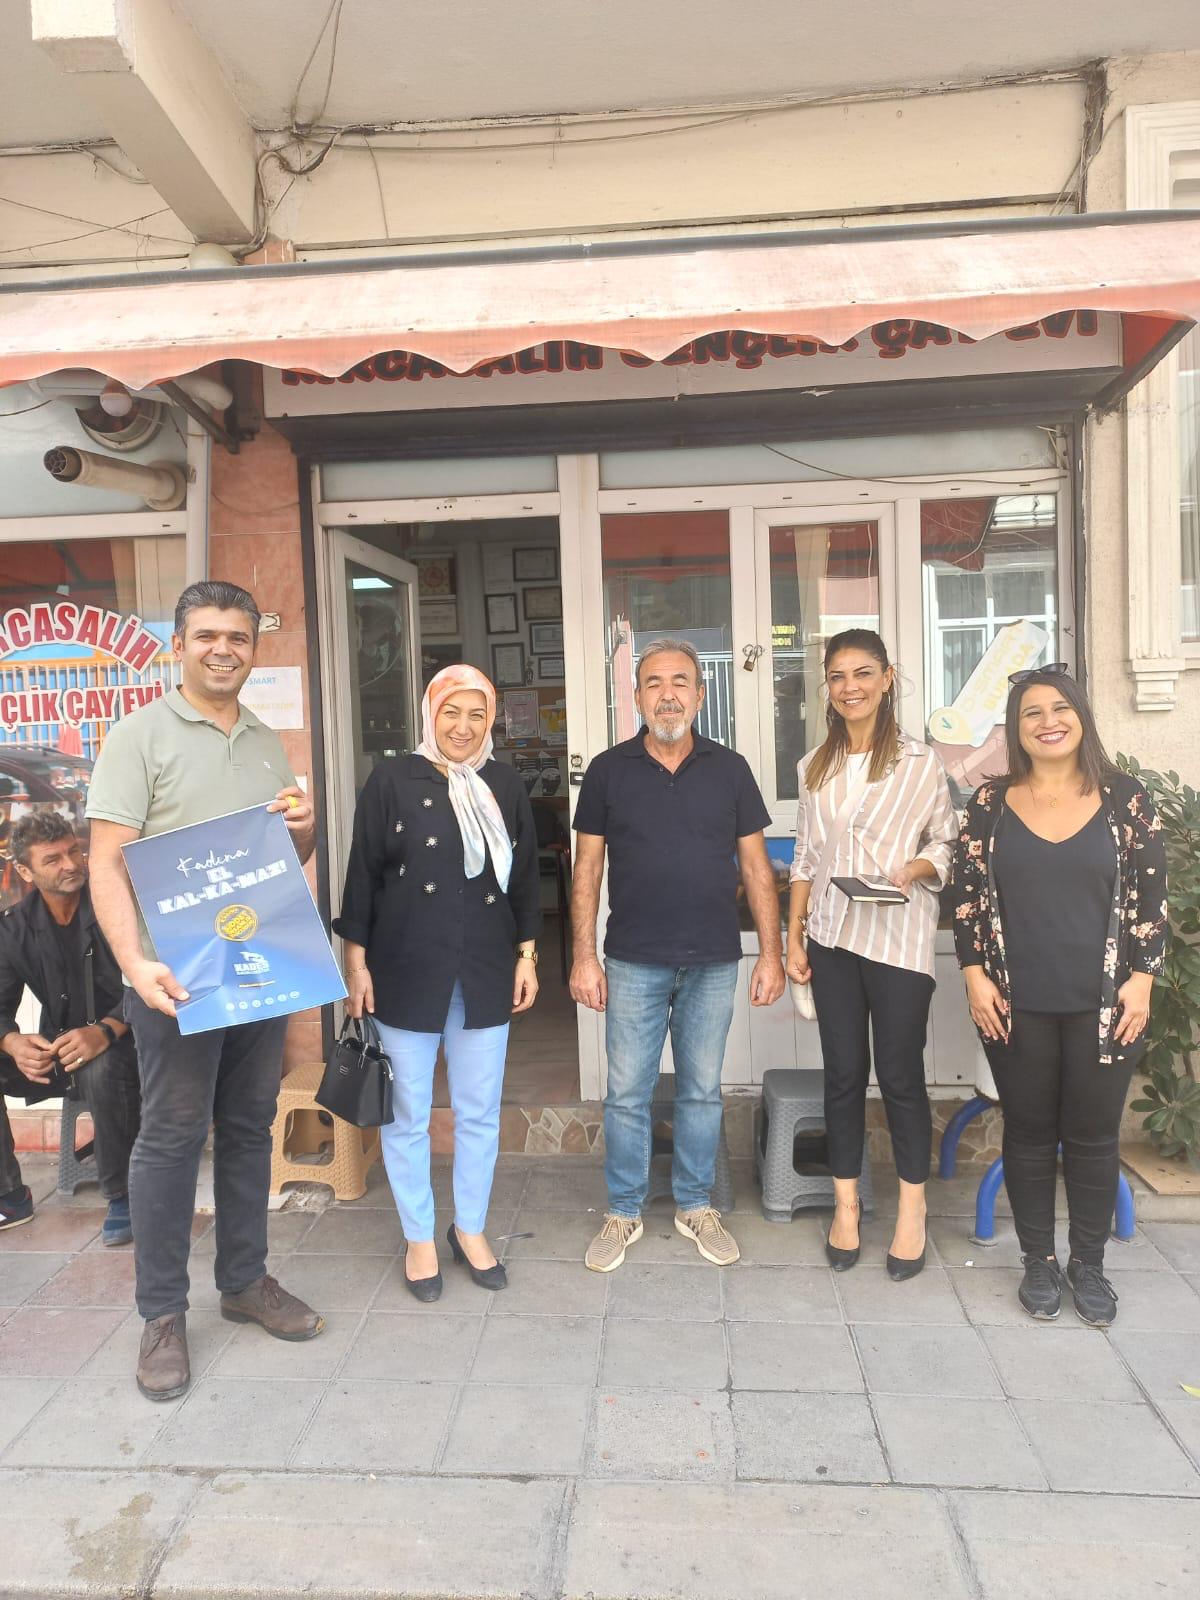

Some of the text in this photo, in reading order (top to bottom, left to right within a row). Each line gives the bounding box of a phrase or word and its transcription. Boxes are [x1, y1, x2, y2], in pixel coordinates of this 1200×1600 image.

[871, 318, 978, 359] ÇA
[0, 603, 161, 672] CASALİH
[246, 676, 277, 686] -SMART
[66, 688, 115, 728] ÇAY
